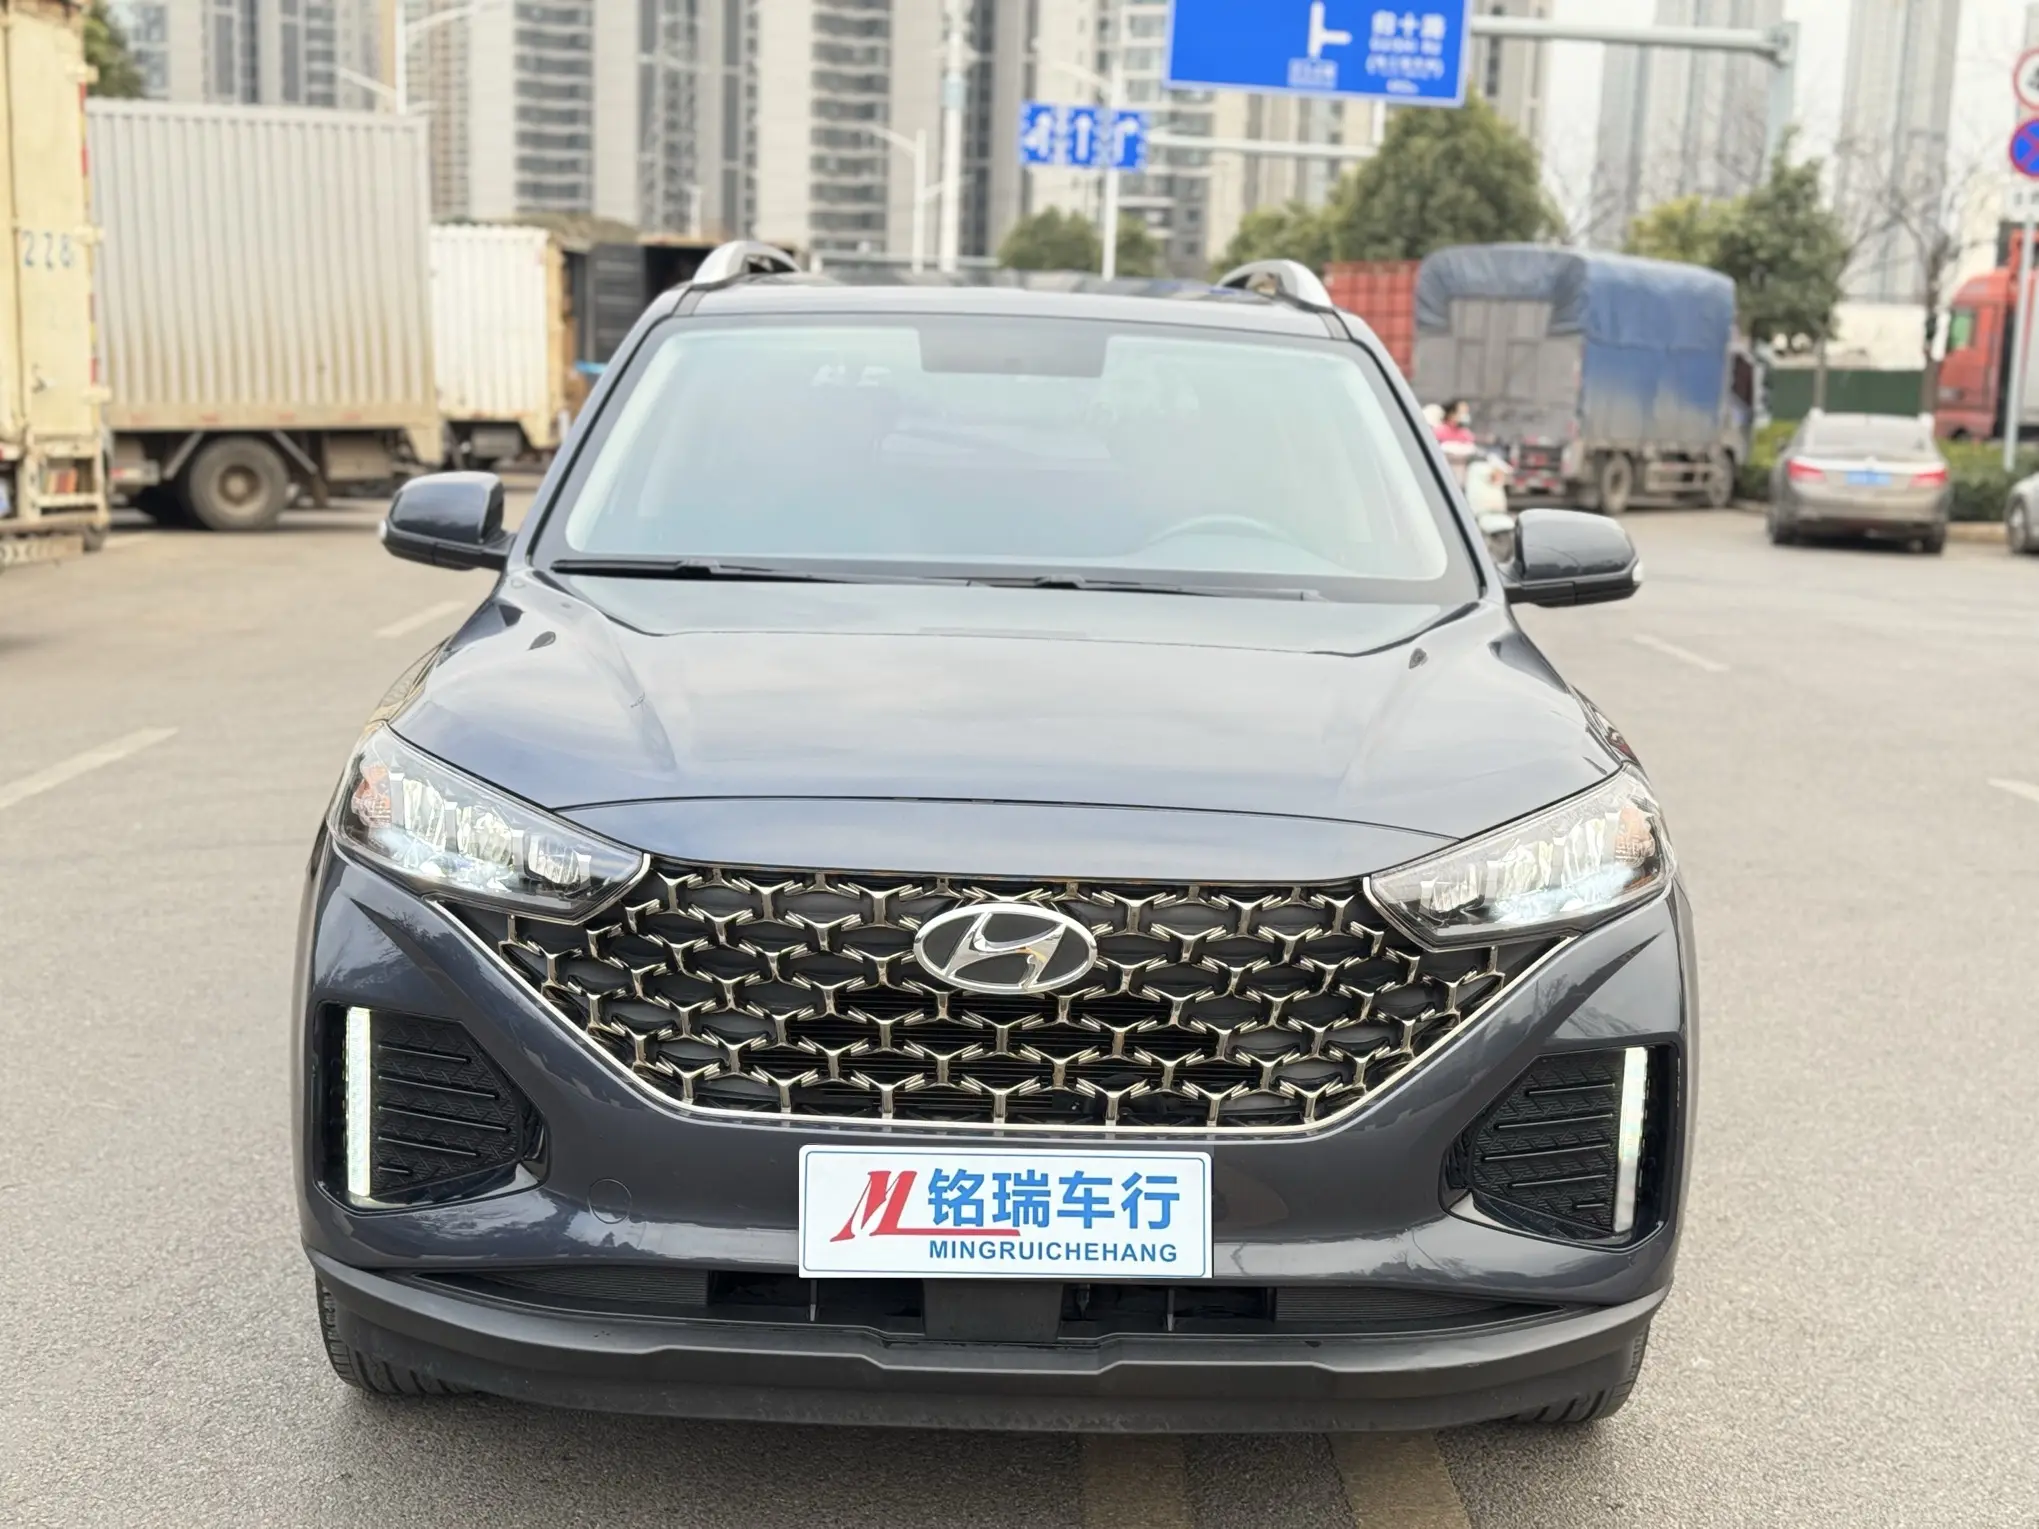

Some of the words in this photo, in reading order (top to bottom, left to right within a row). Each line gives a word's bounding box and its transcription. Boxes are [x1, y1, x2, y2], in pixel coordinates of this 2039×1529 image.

[927, 1168, 1180, 1230] 铭瑞车行
[929, 1240, 1177, 1263] MINGRUICHEHANG
